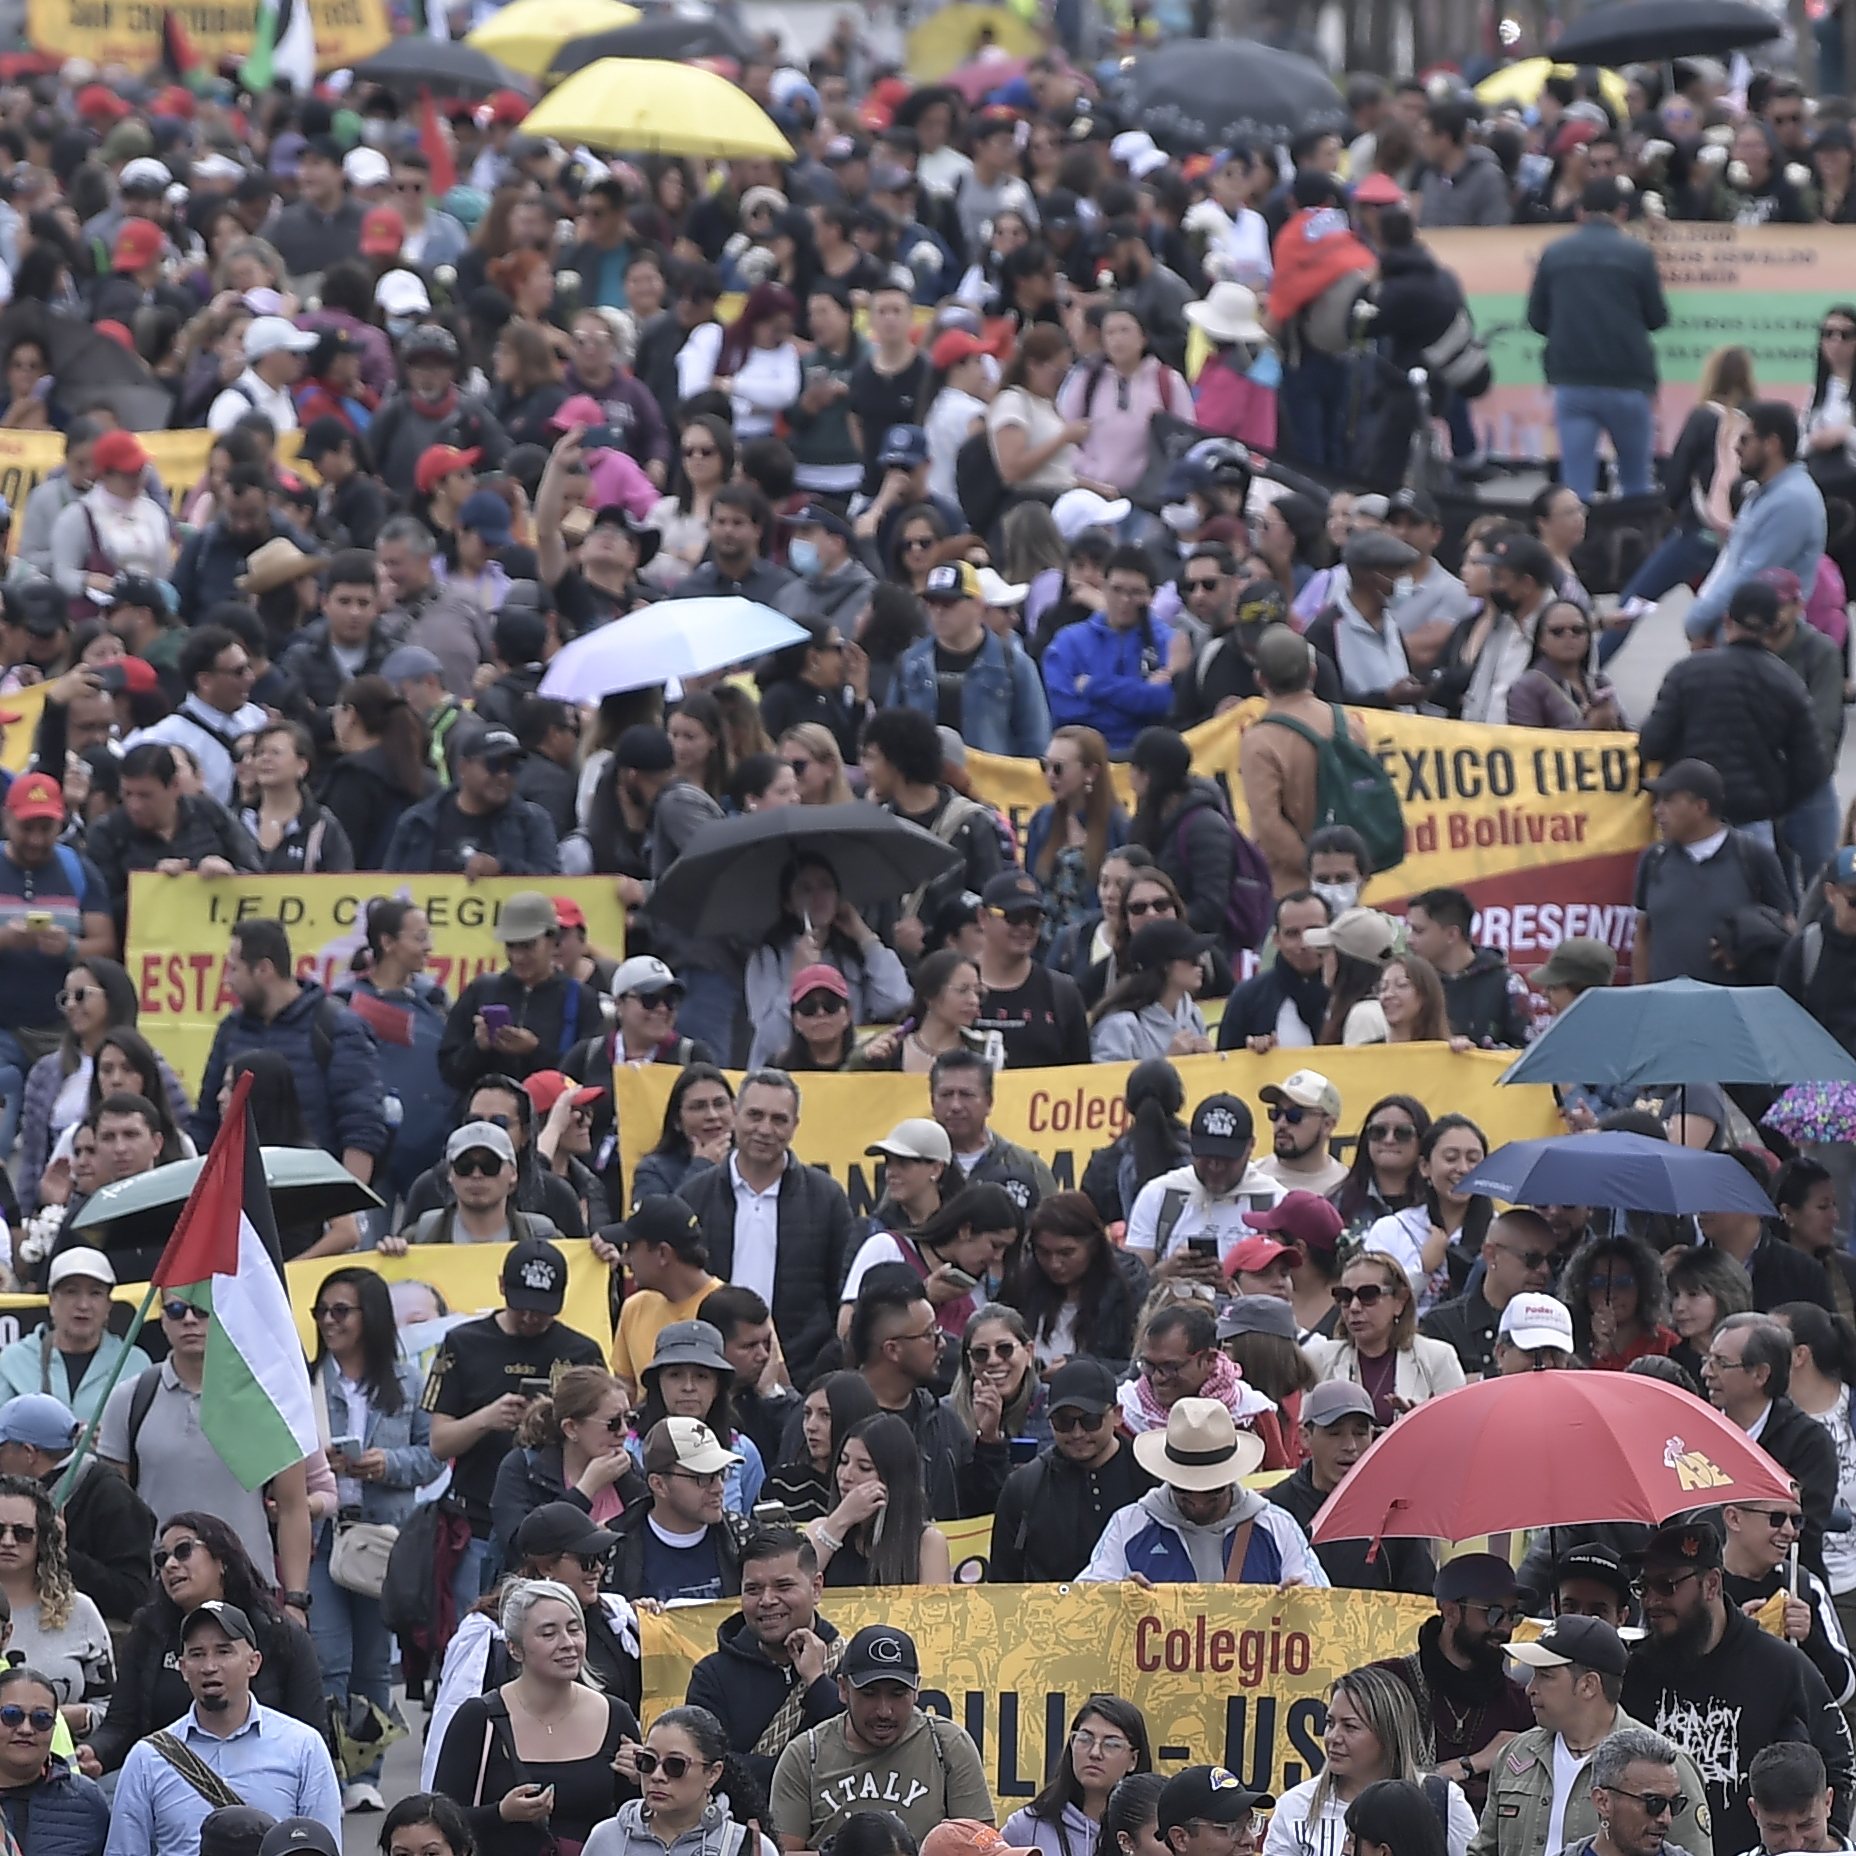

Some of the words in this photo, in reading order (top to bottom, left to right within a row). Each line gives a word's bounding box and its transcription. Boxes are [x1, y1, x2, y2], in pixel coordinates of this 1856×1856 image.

[1380, 738, 1515, 802] ÉXICO
[1449, 806, 1591, 850] Bolívar
[334, 897, 501, 929] CEGI
[1028, 1087, 1130, 1141] Coleg
[1136, 1615, 1311, 1688] Colegio
[820, 1771, 929, 1821] ITALY
